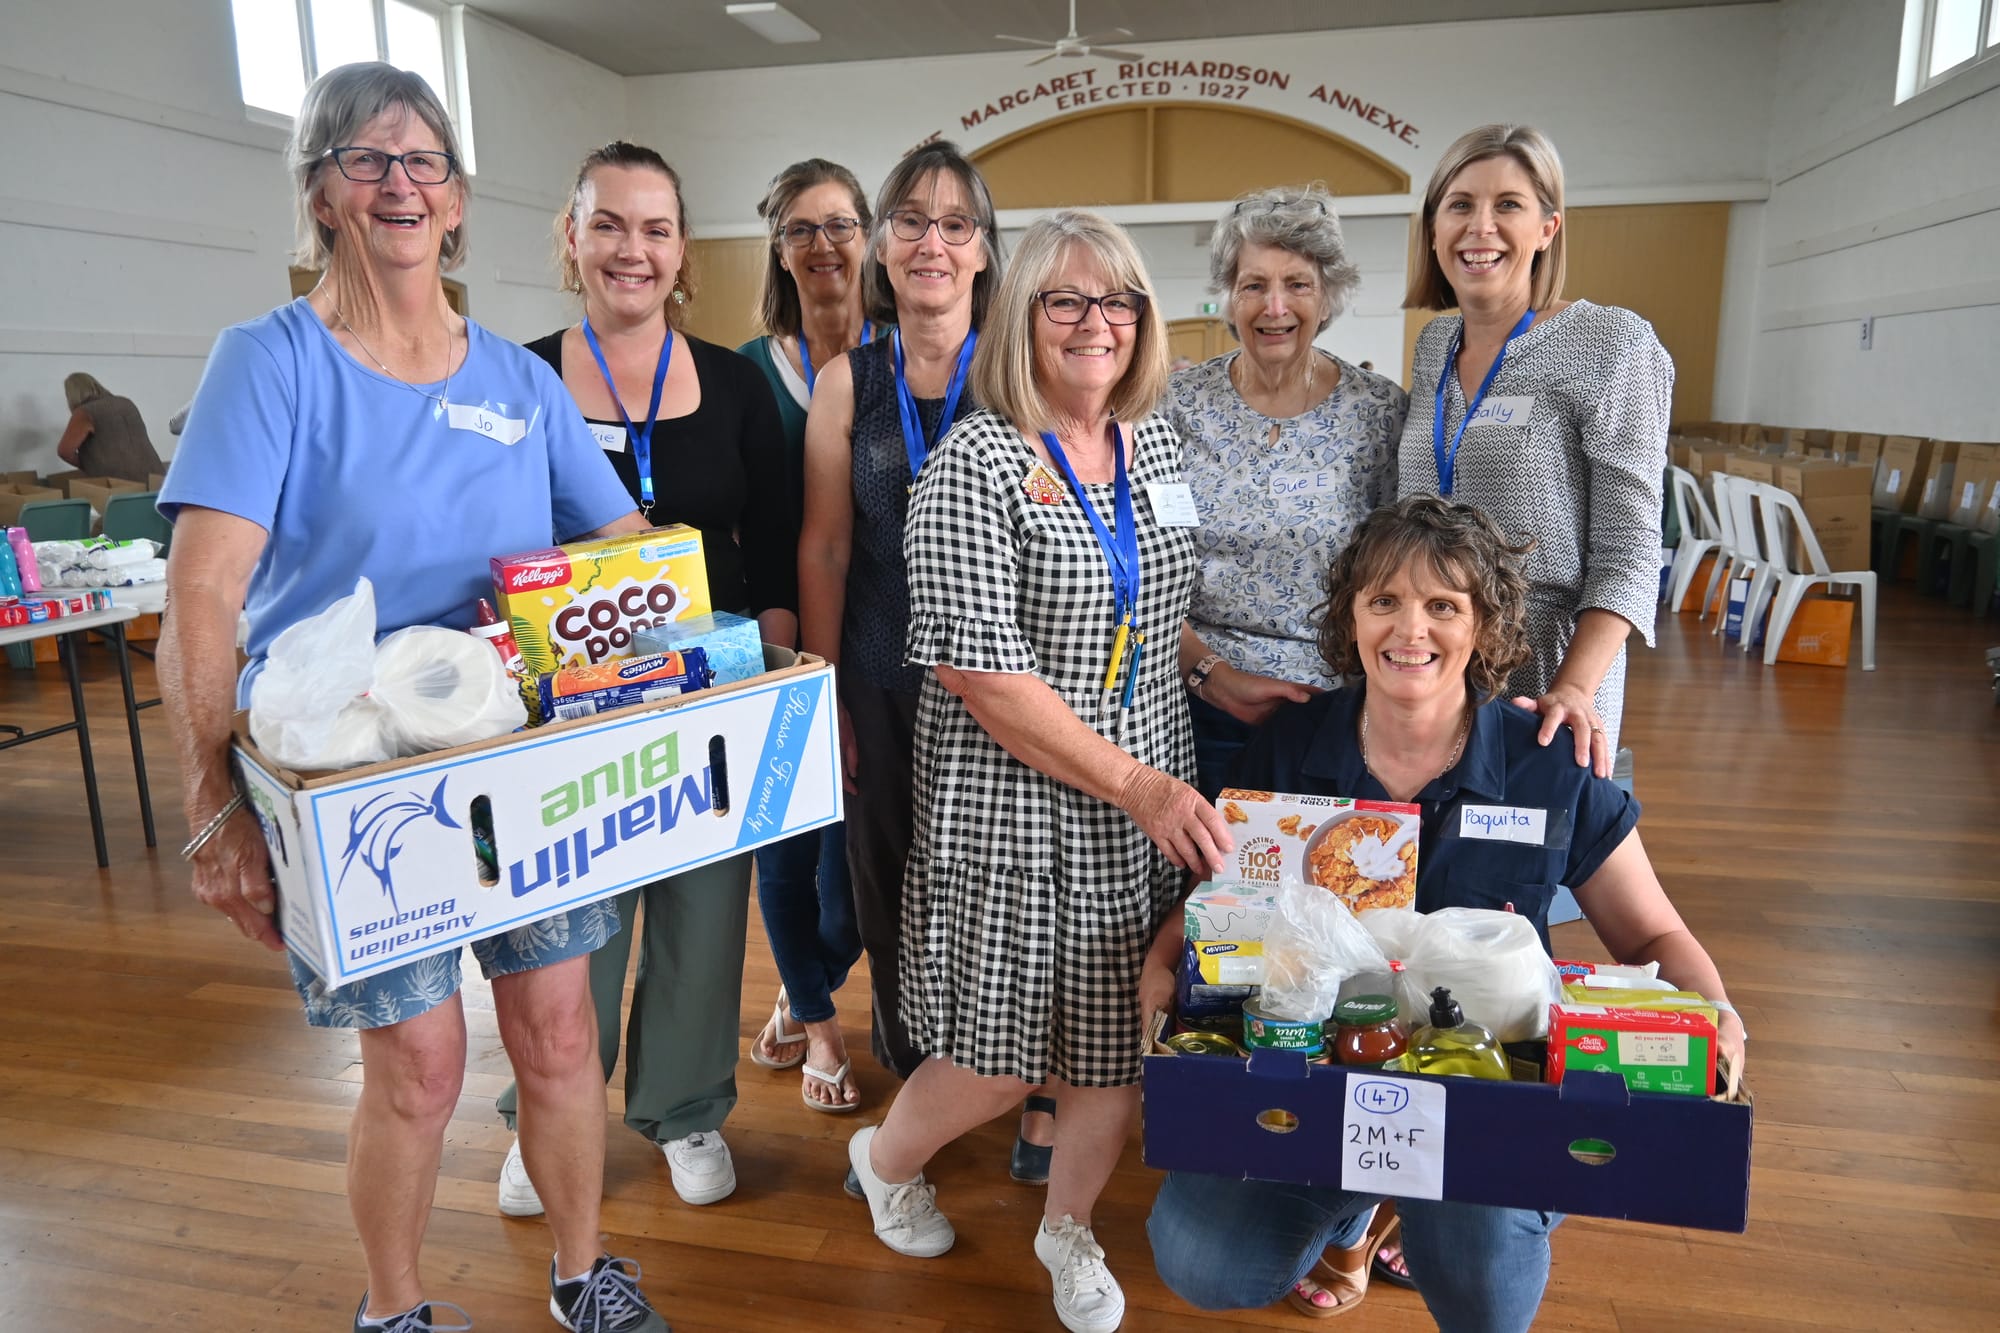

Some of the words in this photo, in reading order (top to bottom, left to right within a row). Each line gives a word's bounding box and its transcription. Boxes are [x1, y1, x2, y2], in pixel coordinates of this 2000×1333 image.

[961, 68, 1096, 131] MARGARET
[1119, 60, 1290, 90] RICHARDSON
[1308, 84, 1419, 149] ANNEXE.
[1056, 81, 1171, 110] ERECTED
[1199, 82, 1249, 100] 1927
[474, 414, 493, 431] Jo
[1272, 477, 1307, 495] Sue
[512, 566, 564, 587] Kellogg's
[777, 687, 810, 750] Russo
[540, 730, 680, 827] Blue
[746, 756, 793, 835] Family
[509, 765, 711, 898] Marlin
[1465, 808, 1531, 834] Paquita
[1240, 867, 1280, 881] YEARS
[1247, 852, 1280, 869] 100
[349, 898, 456, 940] Bananas
[350, 911, 477, 961] Australian
[1274, 1027, 1306, 1040] tuna
[1361, 1087, 1401, 1107] 147
